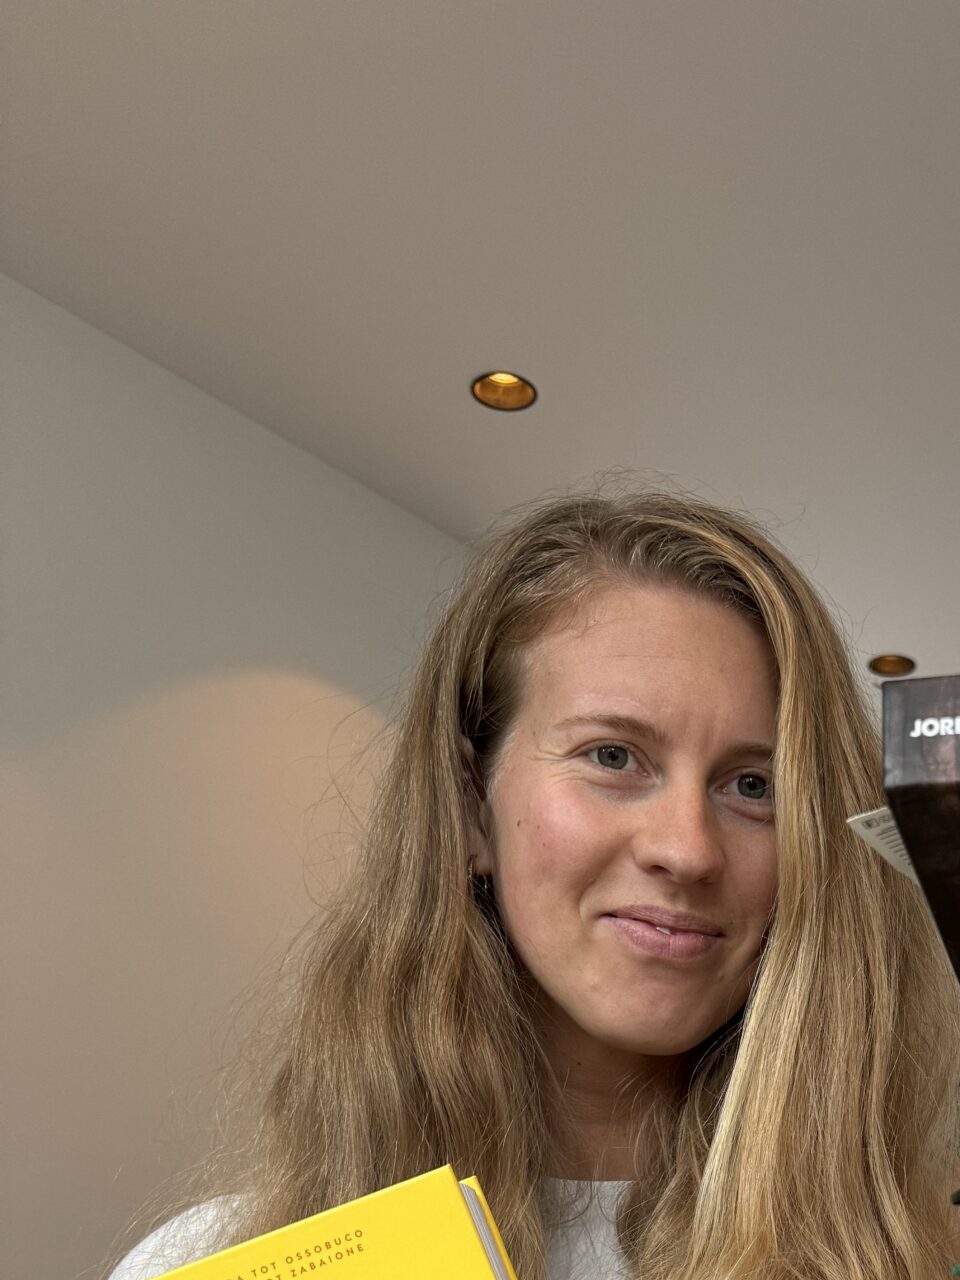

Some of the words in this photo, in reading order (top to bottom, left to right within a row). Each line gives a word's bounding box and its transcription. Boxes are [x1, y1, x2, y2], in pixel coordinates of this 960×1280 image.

[251, 1261, 278, 1278] TOT
[285, 1229, 364, 1265] OSSOBUCO
[290, 1243, 366, 1279] ZABAIONE
